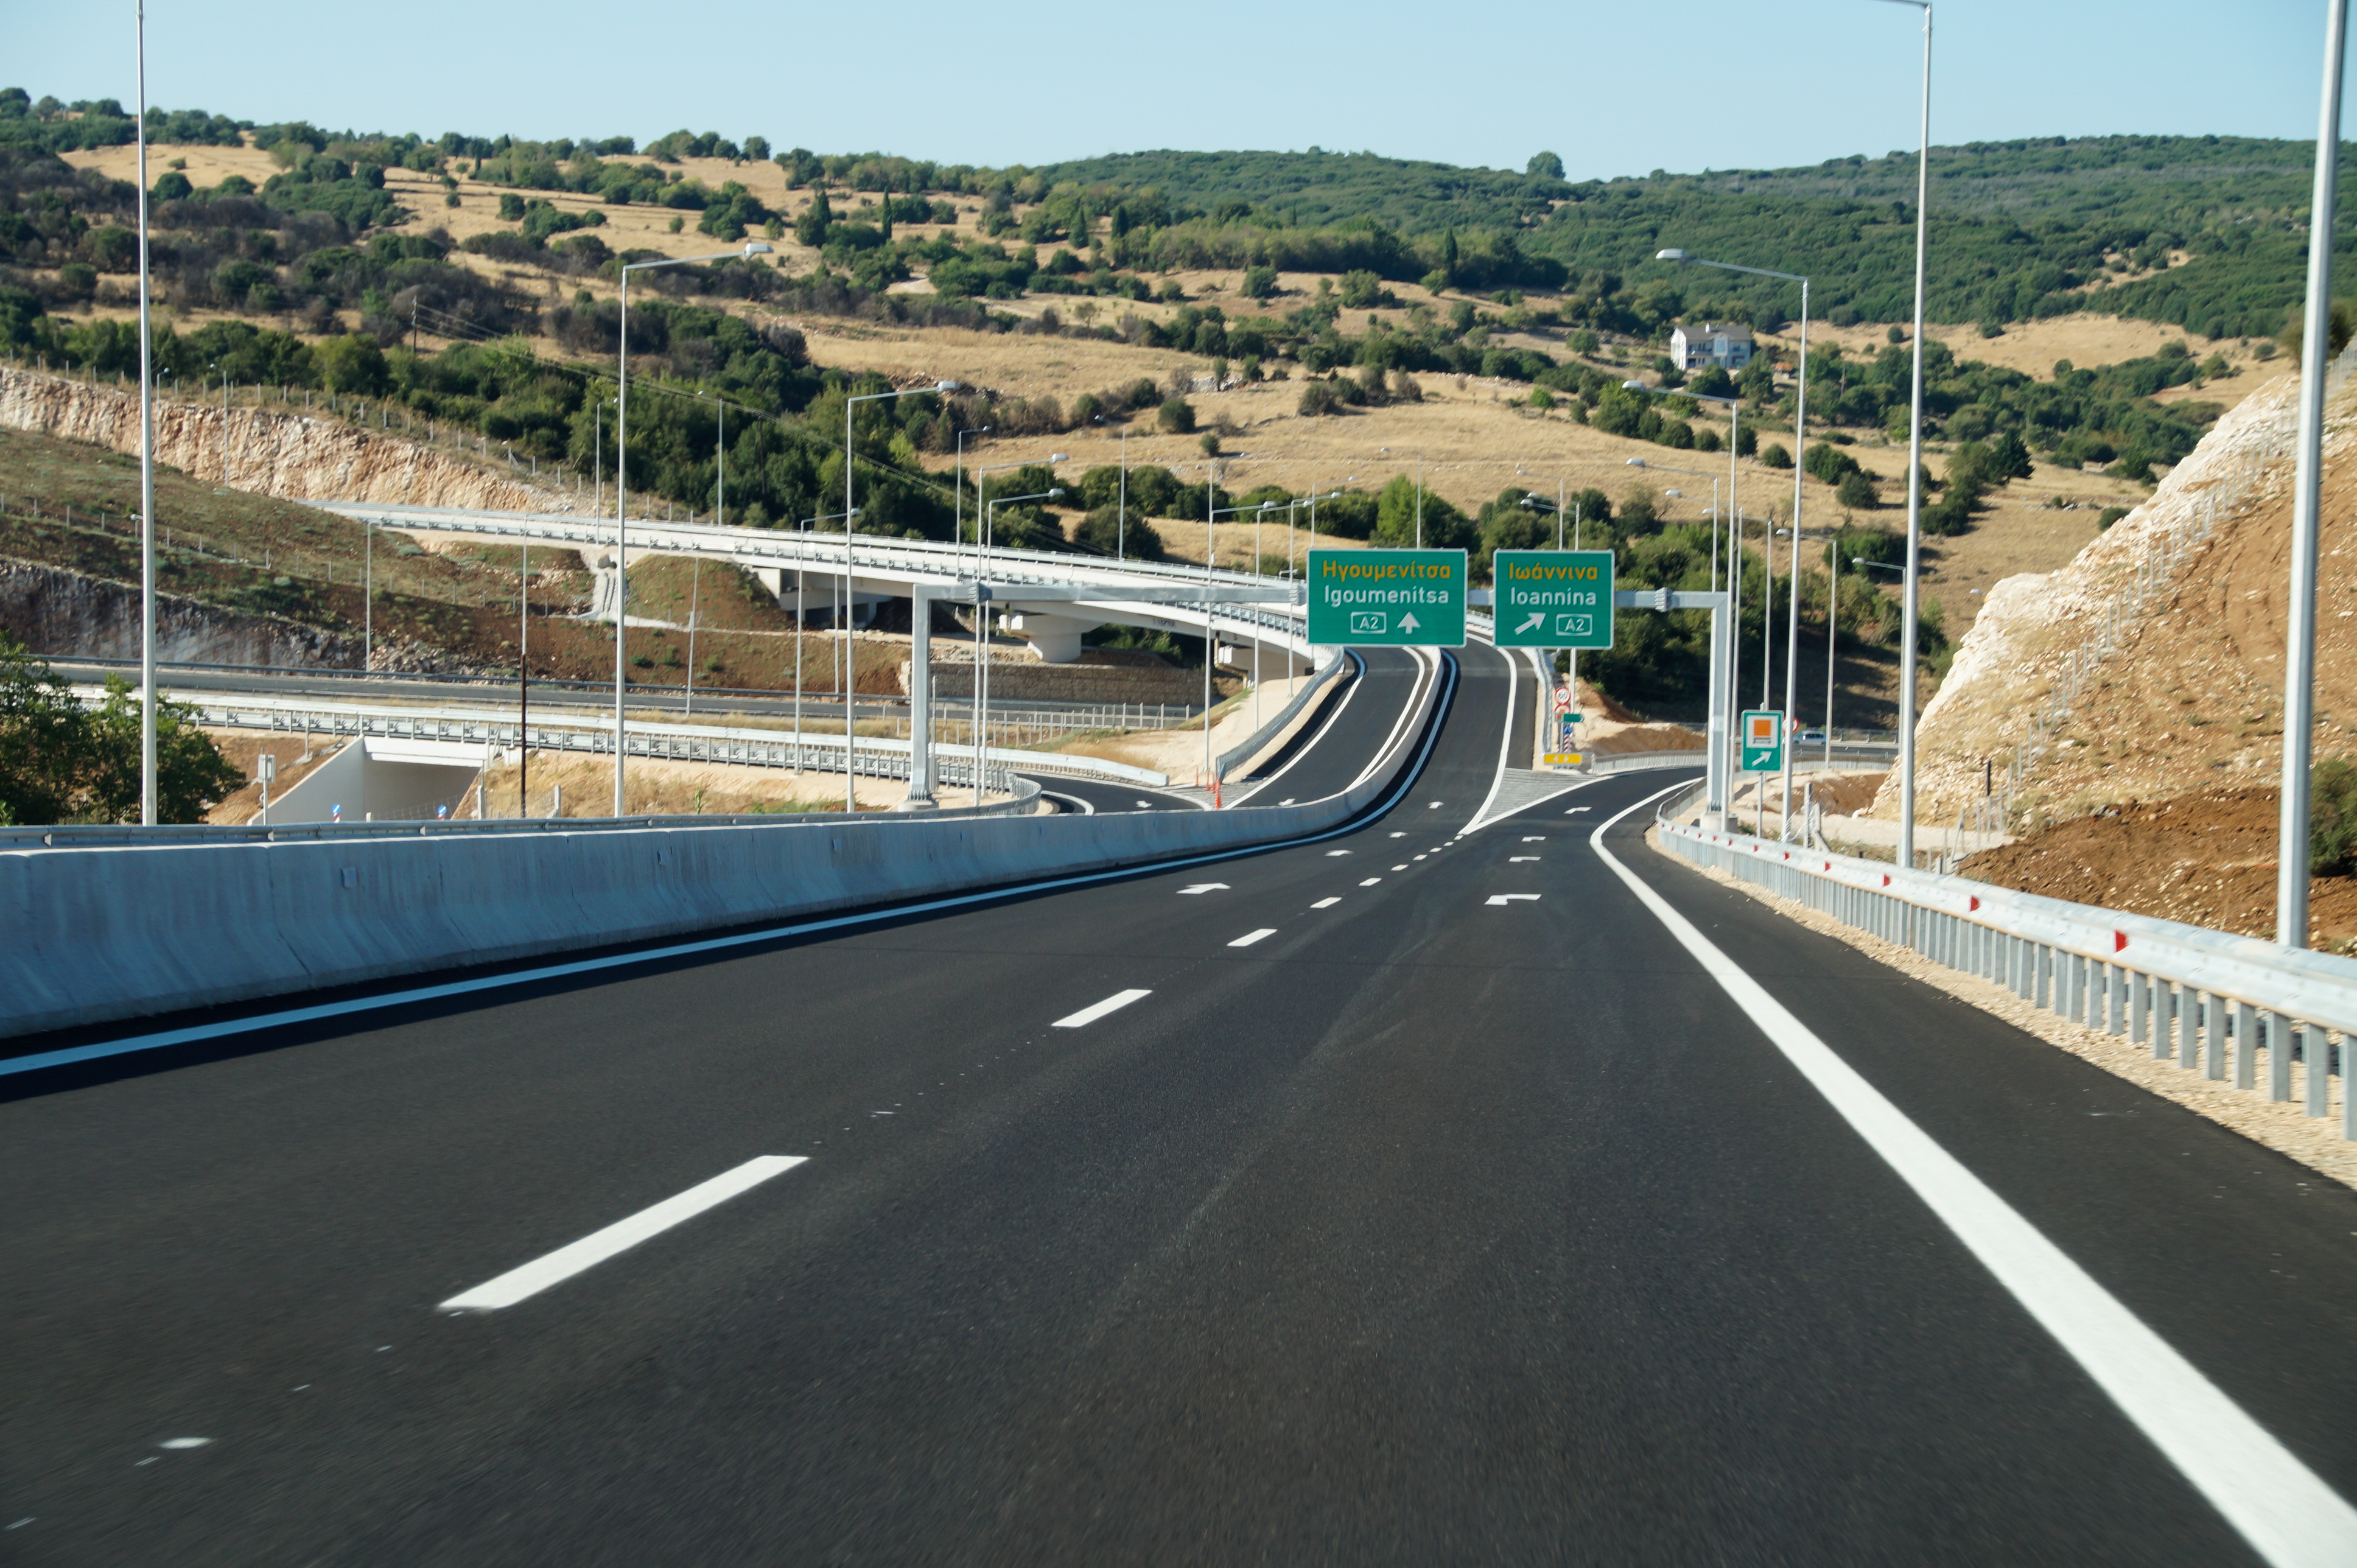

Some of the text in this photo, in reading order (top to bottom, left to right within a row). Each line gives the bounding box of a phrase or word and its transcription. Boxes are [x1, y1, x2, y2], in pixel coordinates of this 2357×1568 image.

[1323, 560, 1451, 583] Ηγουμενίτσα
[1509, 562, 1598, 580] Ιωάννινα
[1325, 584, 1449, 607] Igoumenitsa
[1510, 586, 1597, 606] Ioannina
[1359, 615, 1379, 629] A2
[1564, 617, 1585, 632] A2
